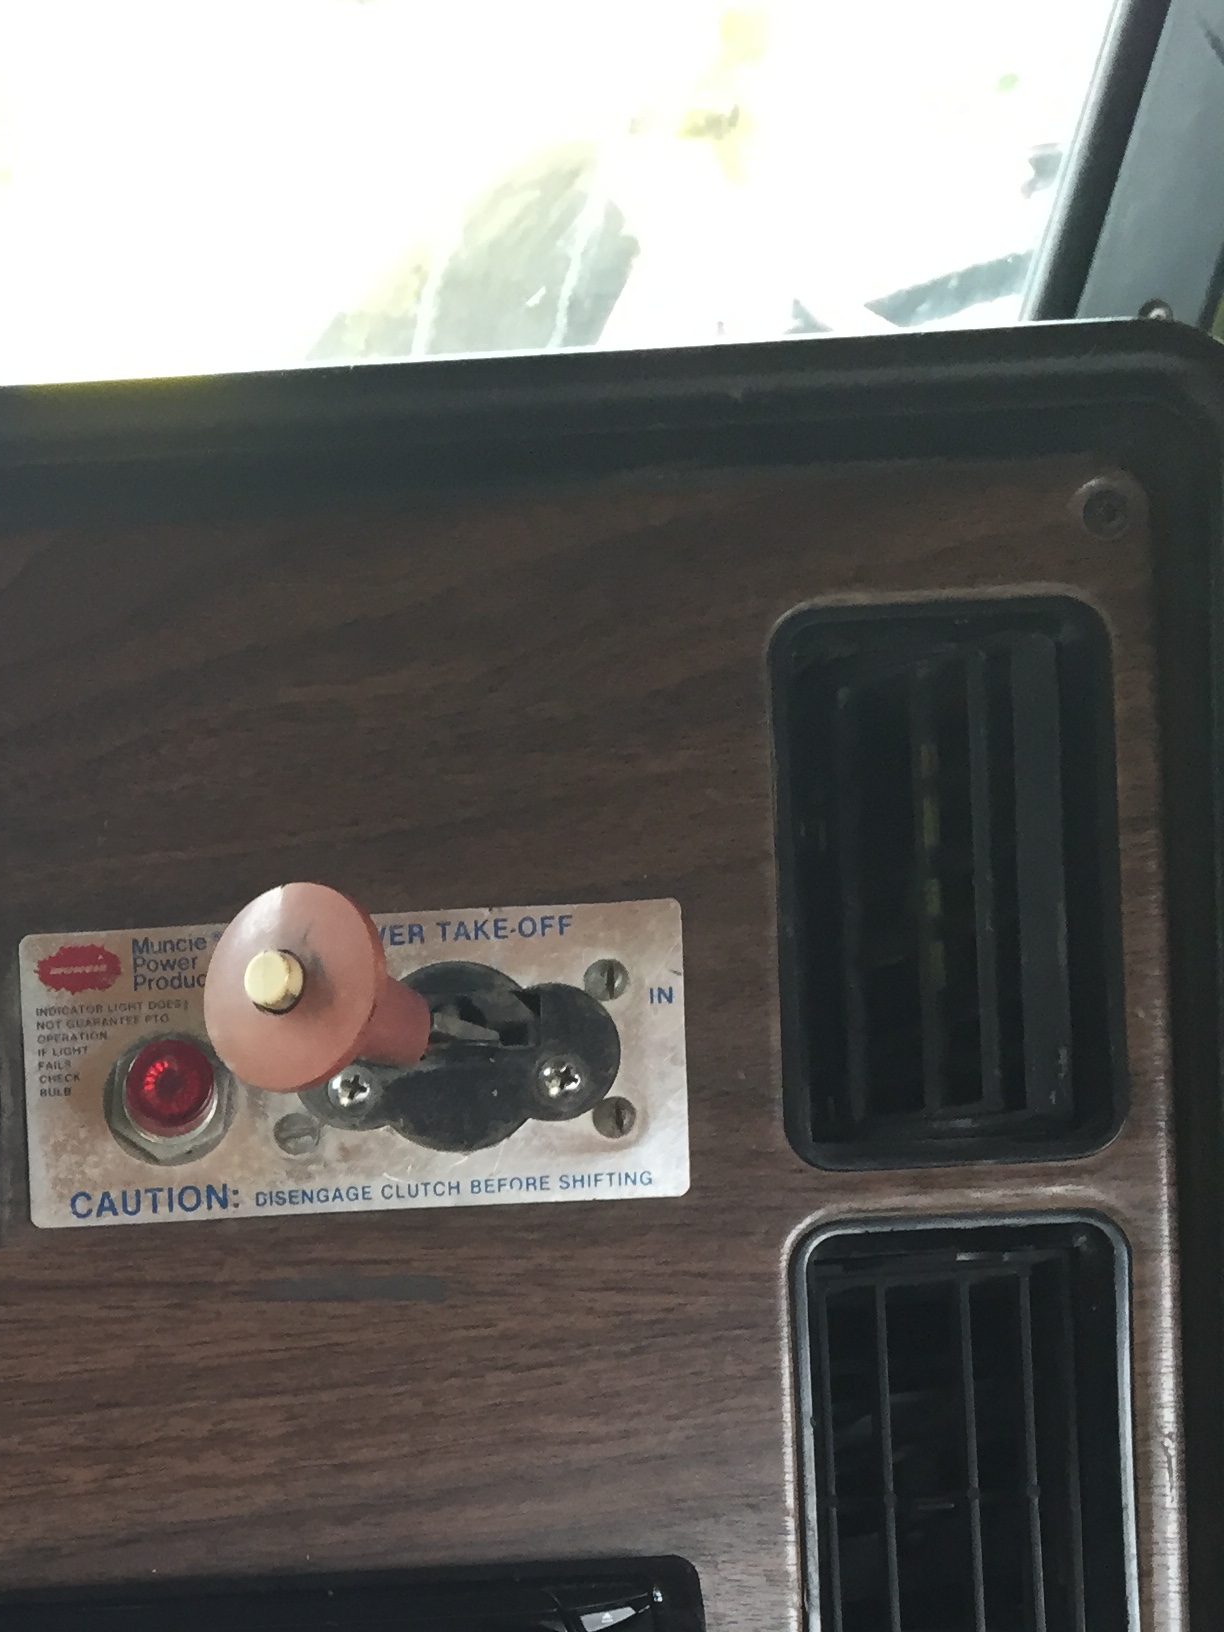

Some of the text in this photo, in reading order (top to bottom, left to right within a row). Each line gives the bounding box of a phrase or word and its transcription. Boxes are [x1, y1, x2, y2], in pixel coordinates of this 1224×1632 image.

[436, 915, 573, 942] TAKE-OFF
[132, 936, 207, 954] Muncie
[132, 955, 198, 973] Power
[133, 972, 206, 991] Produc
[650, 987, 673, 1004] IN
[36, 1003, 103, 1016] INDICATOR
[108, 1001, 142, 1013] LIGHT
[36, 1014, 169, 1030] NOT GUARANTEE PTO
[37, 1031, 108, 1044] OPERATION
[37, 1046, 88, 1057] IF LIGHT
[38, 1060, 71, 1070] FAILS
[39, 1074, 80, 1084] CHECK
[40, 1088, 71, 1098] BULB
[70, 1171, 653, 1219] CAUTION: DISENGAGE CLUTCH BEFORE SHIFTING
